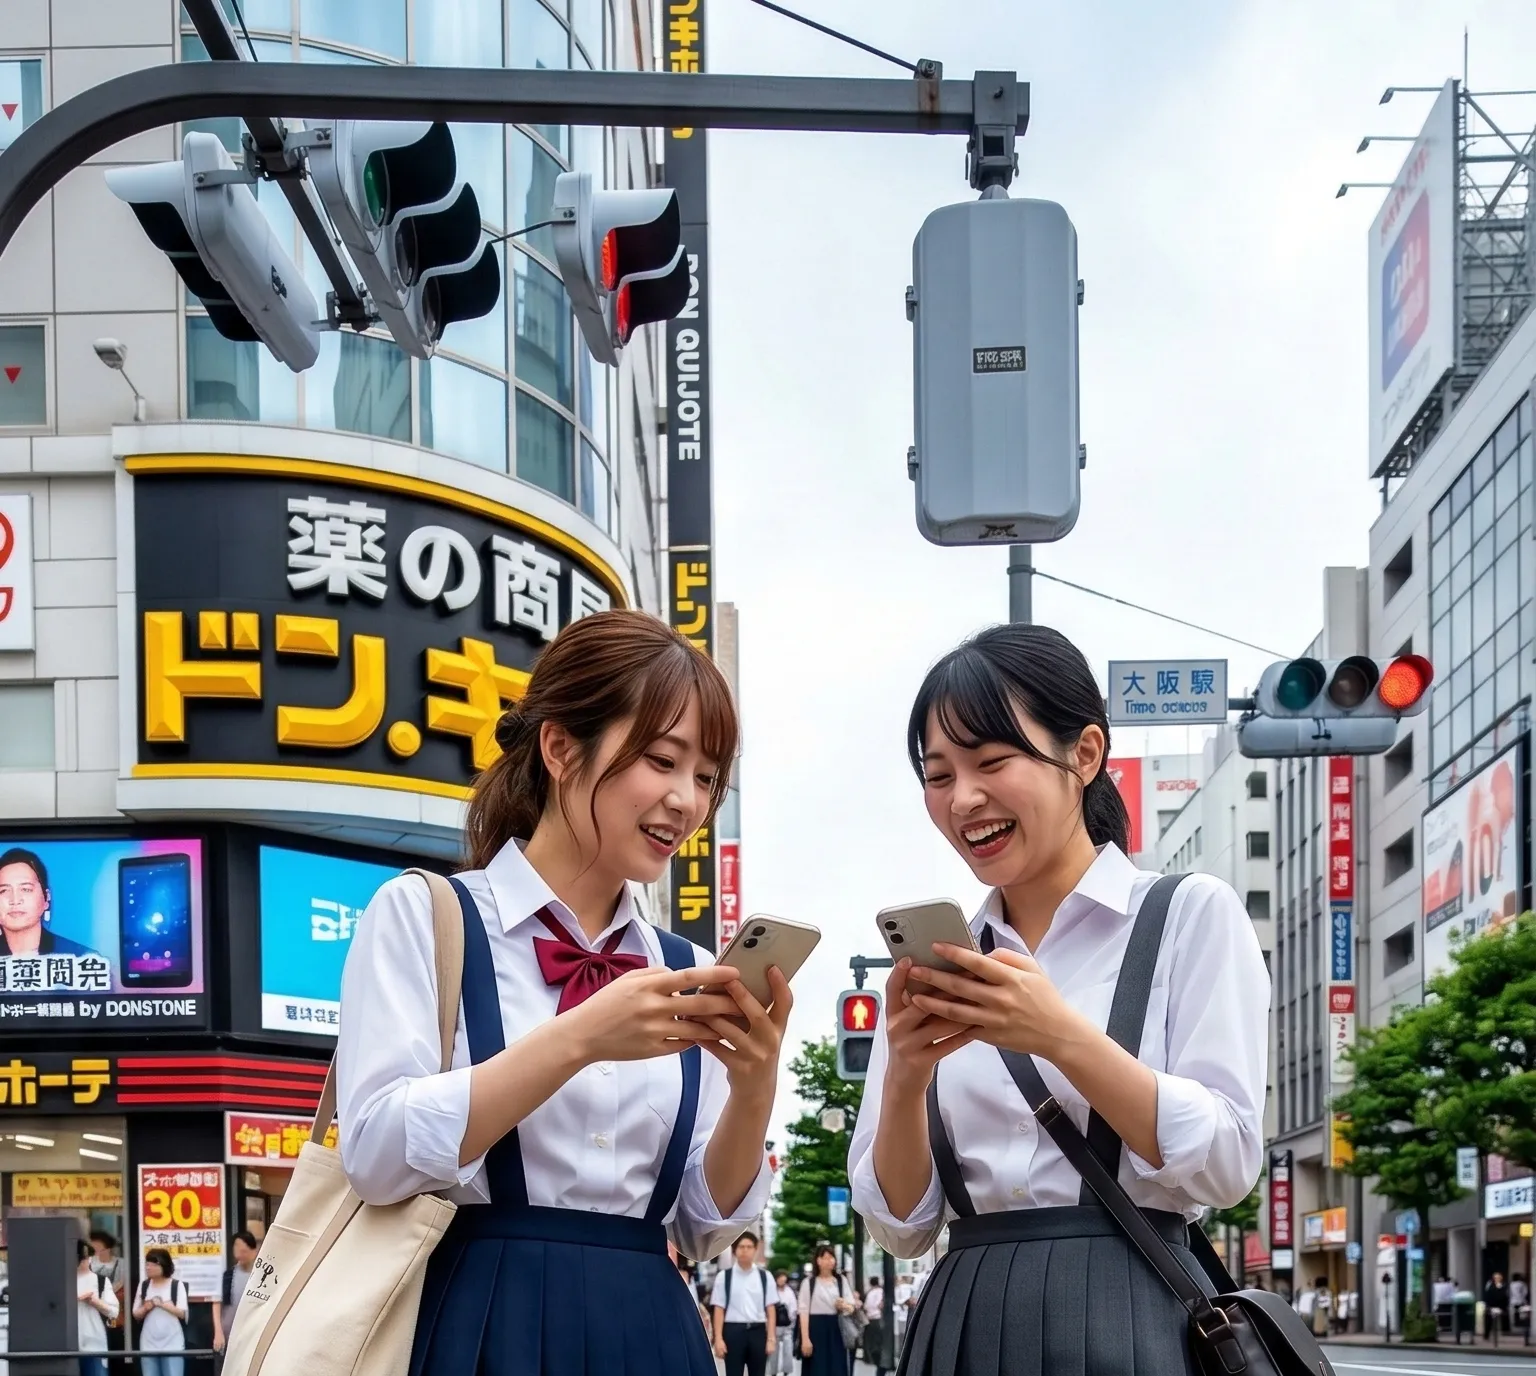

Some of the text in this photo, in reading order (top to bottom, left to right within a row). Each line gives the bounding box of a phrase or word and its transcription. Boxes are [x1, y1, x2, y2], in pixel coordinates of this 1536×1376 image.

[676, 328, 700, 460] QUIJOTE
[79, 1000, 102, 1019] by
[106, 999, 197, 1017] DONSTONE
[144, 1189, 201, 1229] 30
